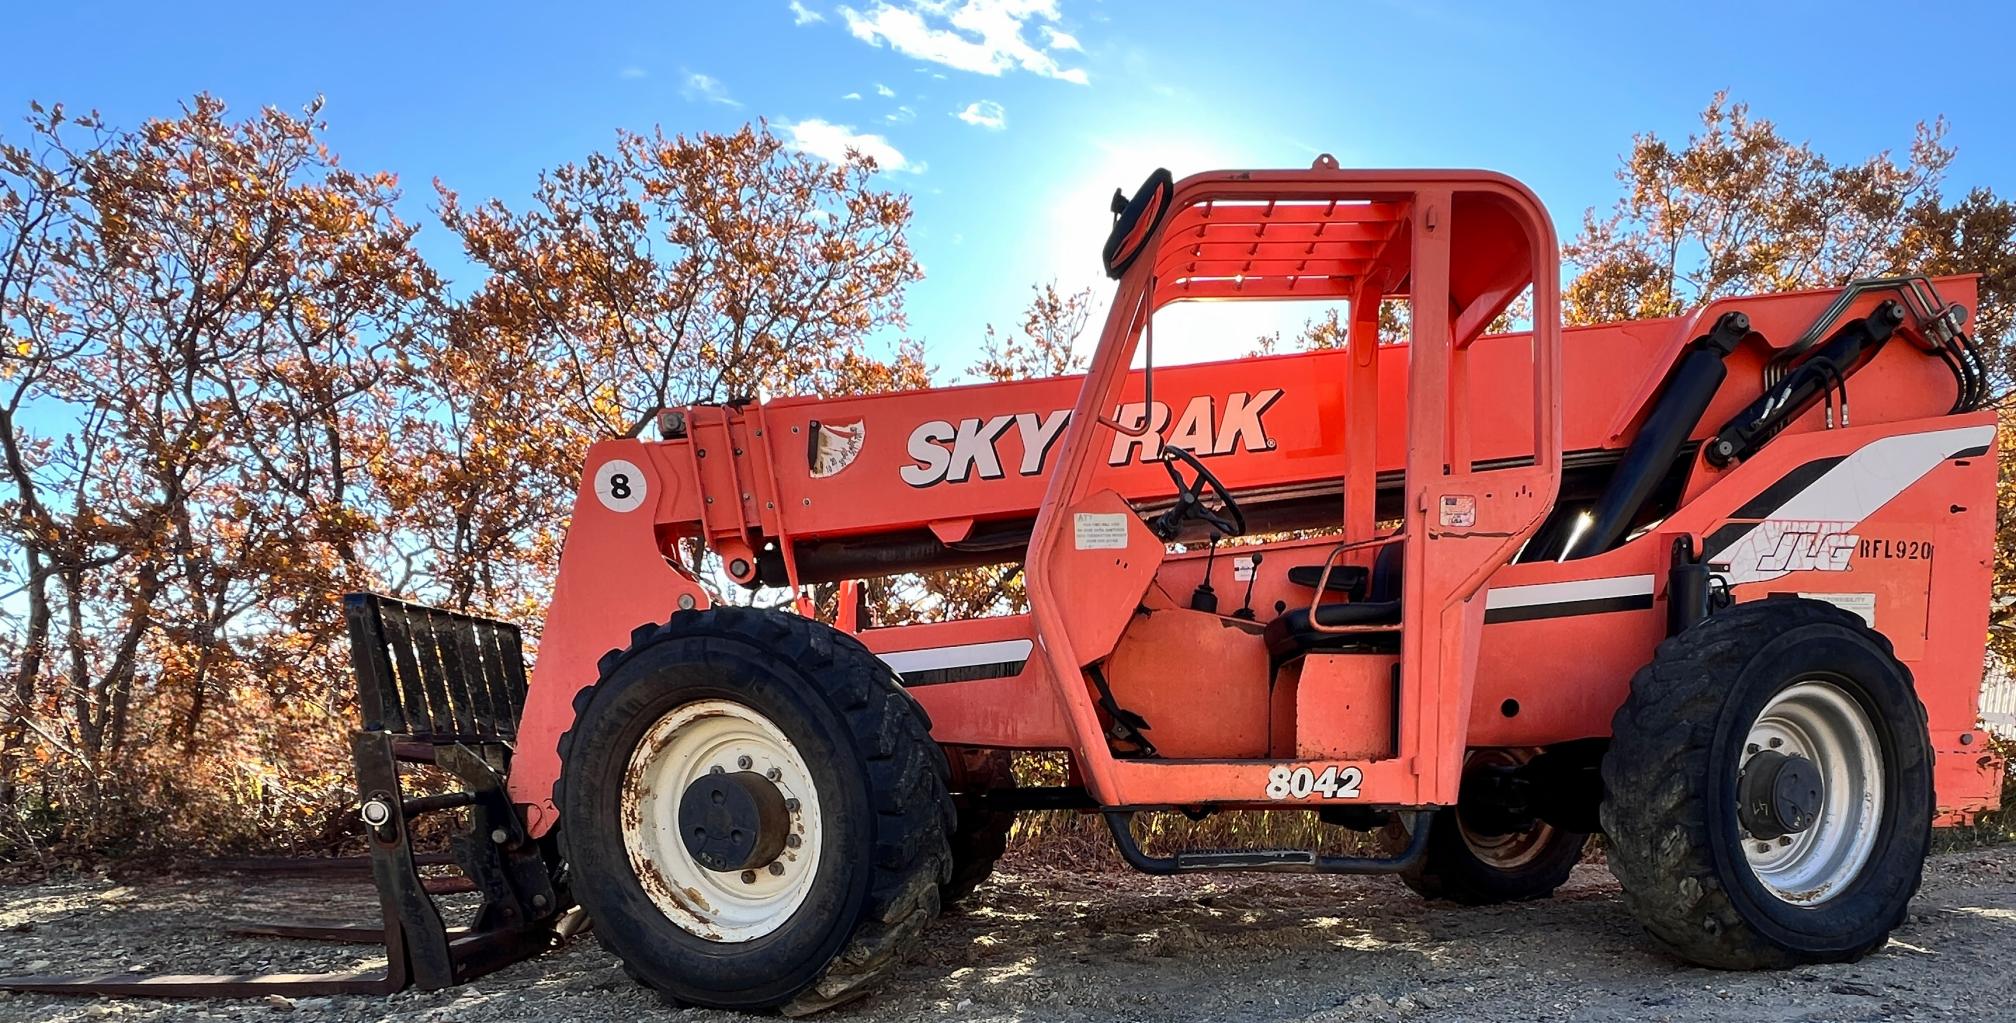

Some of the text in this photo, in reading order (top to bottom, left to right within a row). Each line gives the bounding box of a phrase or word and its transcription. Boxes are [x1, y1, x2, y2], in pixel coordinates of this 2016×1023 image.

[899, 389, 1284, 488] SKYRAK
[611, 474, 631, 499] 8
[1756, 532, 1860, 571] JLG
[1859, 540, 1932, 560] RFL920
[1266, 765, 1363, 800] 8042
